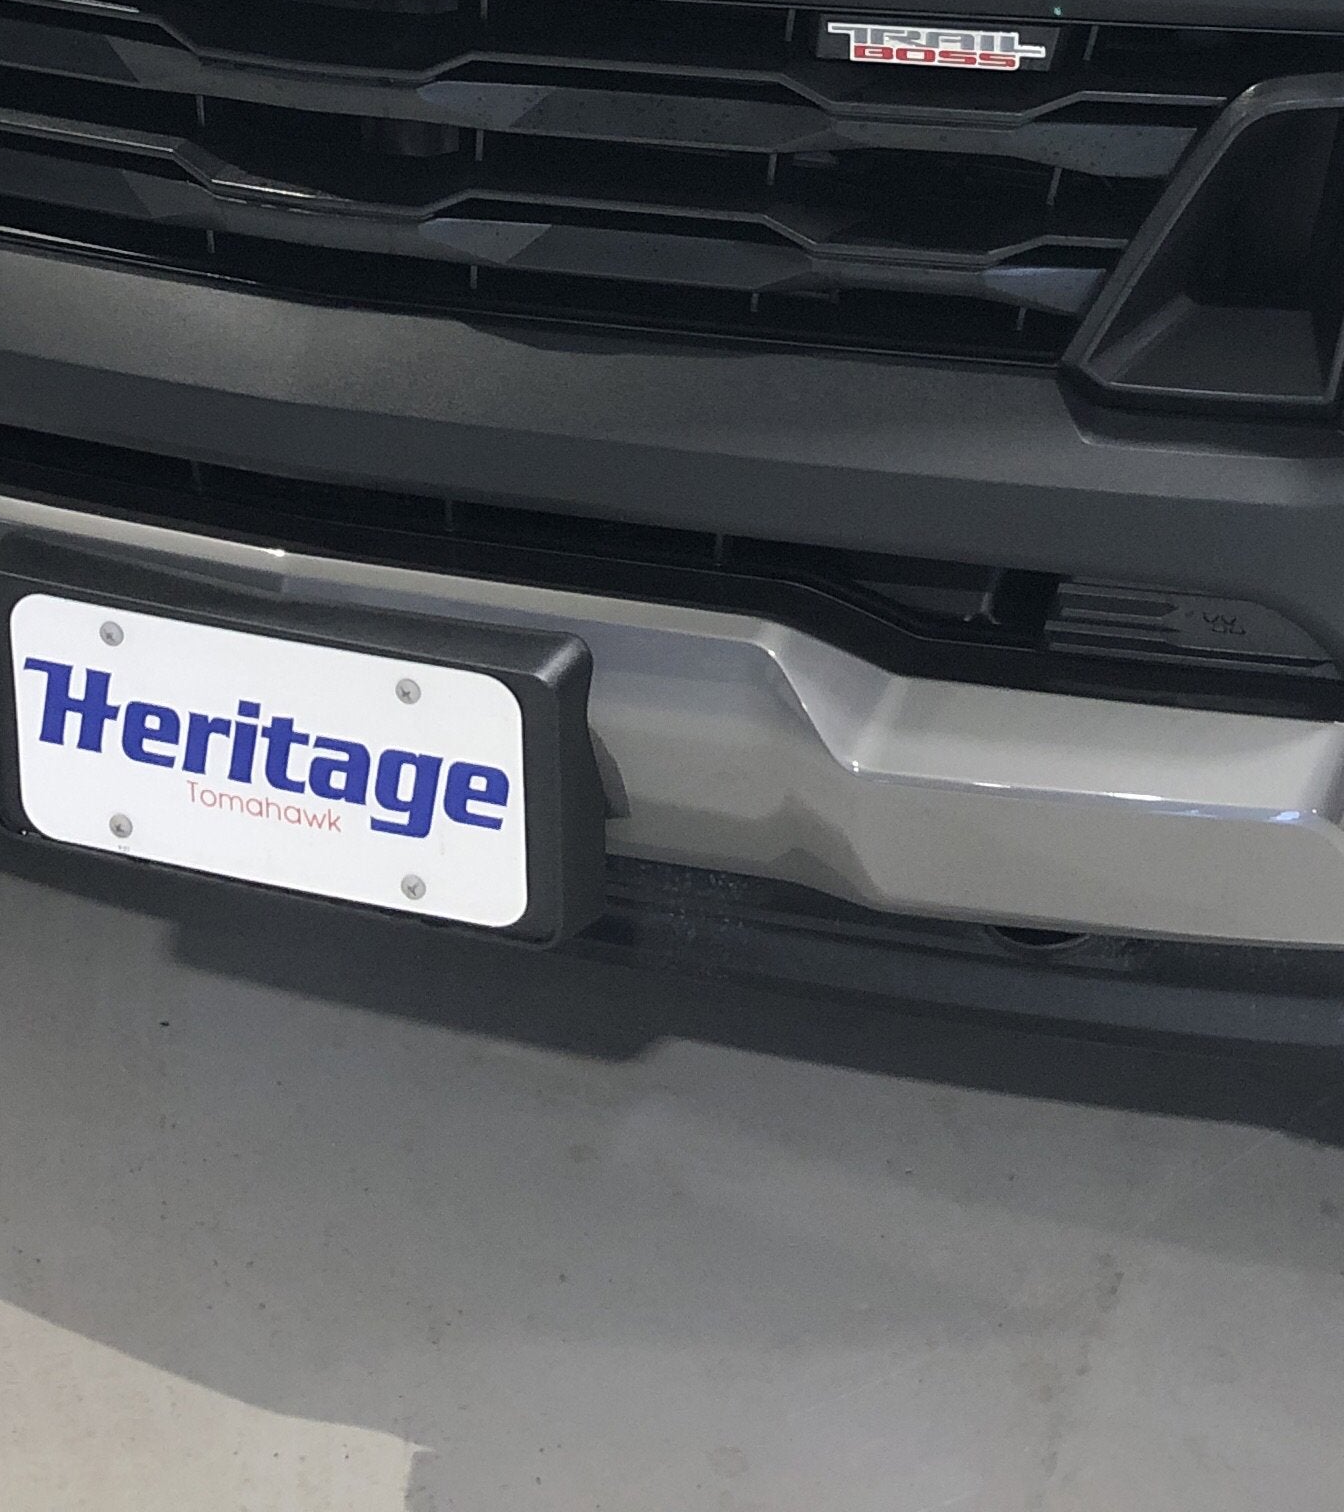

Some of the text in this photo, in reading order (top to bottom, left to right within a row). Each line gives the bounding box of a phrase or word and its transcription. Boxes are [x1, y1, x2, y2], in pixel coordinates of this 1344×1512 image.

[828, 22, 1046, 58] TRAIL
[853, 44, 1017, 70] BOSS
[24, 657, 510, 839] Heritage
[186, 780, 342, 834] Tomahawk
